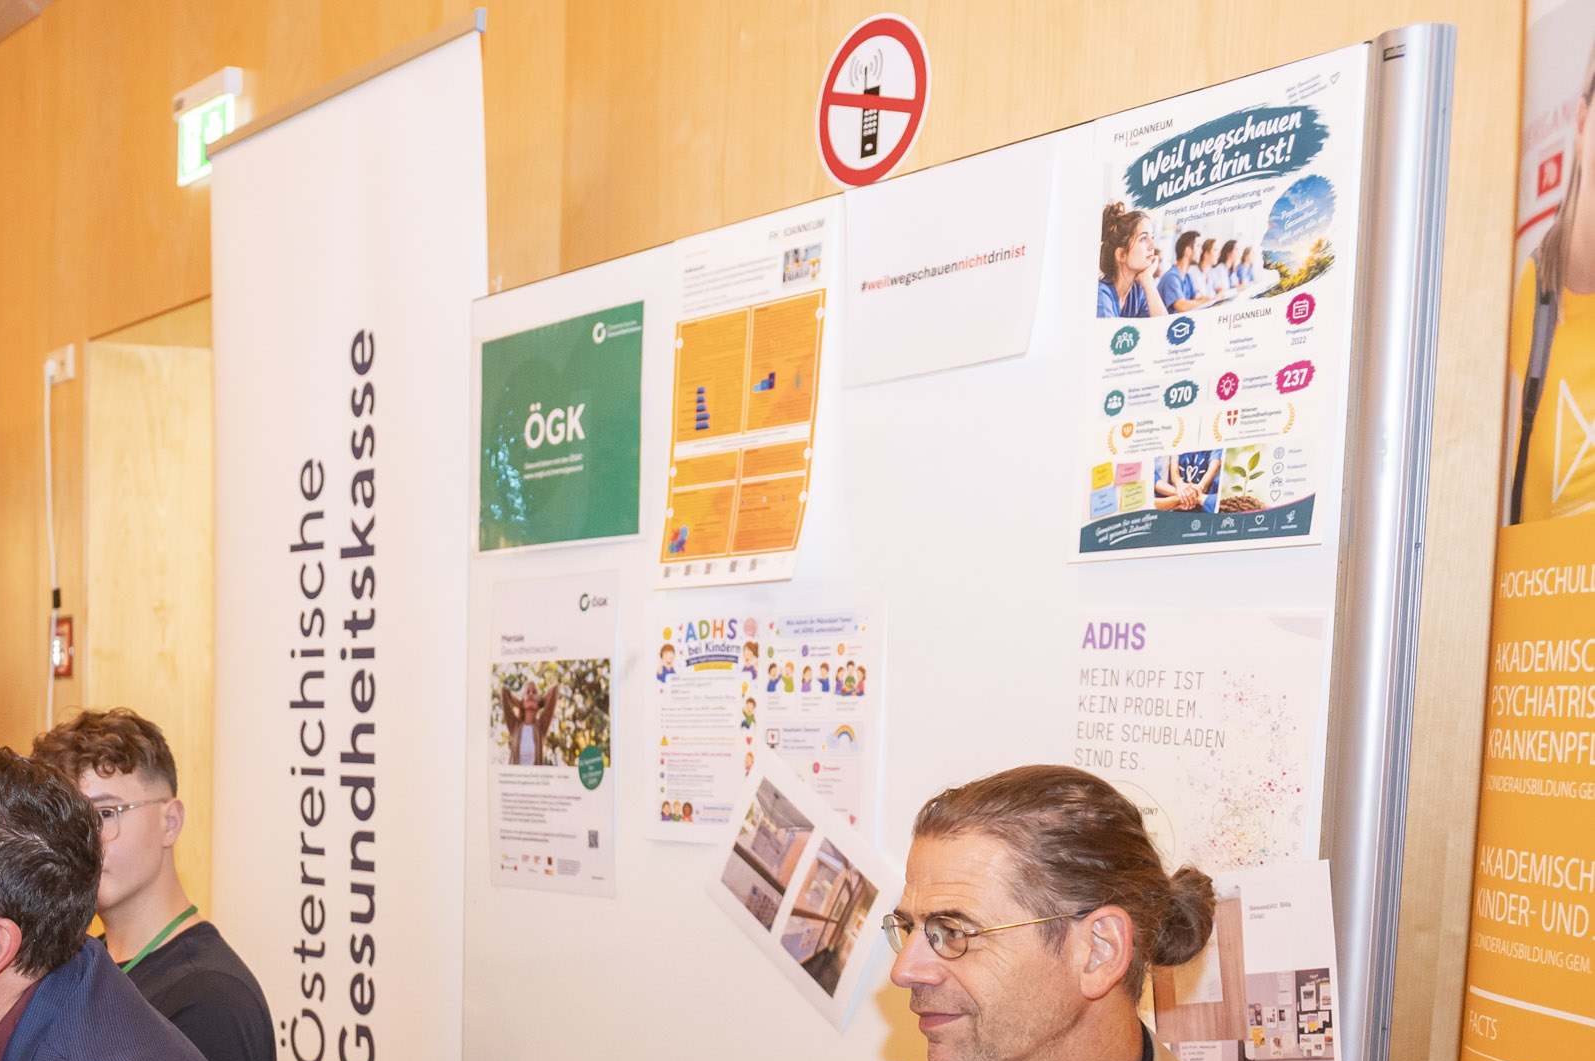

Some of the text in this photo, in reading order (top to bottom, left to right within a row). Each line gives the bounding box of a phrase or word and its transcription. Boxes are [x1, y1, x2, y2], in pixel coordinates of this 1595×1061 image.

[1114, 118, 1174, 143] FH JOANNEUM
[1142, 110, 1302, 187] Weil wegschauen
[1155, 133, 1296, 202] nicht drin ist!
[1164, 184, 1276, 217] Projekt zur Entstigmatisierung von
[1176, 199, 1263, 226] psychischen Erkrankungen
[859, 244, 1025, 292] #weilwegschauennichtdrinist
[1218, 307, 1272, 325] FH JOANNEUM
[1282, 367, 1309, 389] 237
[1169, 385, 1193, 405] 970
[524, 401, 586, 450] ÖGK
[685, 617, 738, 643] ADHS
[1081, 621, 1147, 651] ADHS
[687, 641, 742, 656] bei Kindern
[1079, 667, 1206, 691] MEIN KOPF IST
[1077, 694, 1204, 720] KEIN PROBLEM.
[1076, 720, 1226, 749] EURE SCHUBLADEN
[1073, 747, 1146, 772] SIND ES.
[1485, 774, 1578, 799] SONDERAUSBILDUNG
[1475, 887, 1590, 939] KINDER- UND
[1473, 931, 1593, 976] SONDERAUSBILDUNG GEM.
[1468, 1010, 1498, 1041] FACTS
